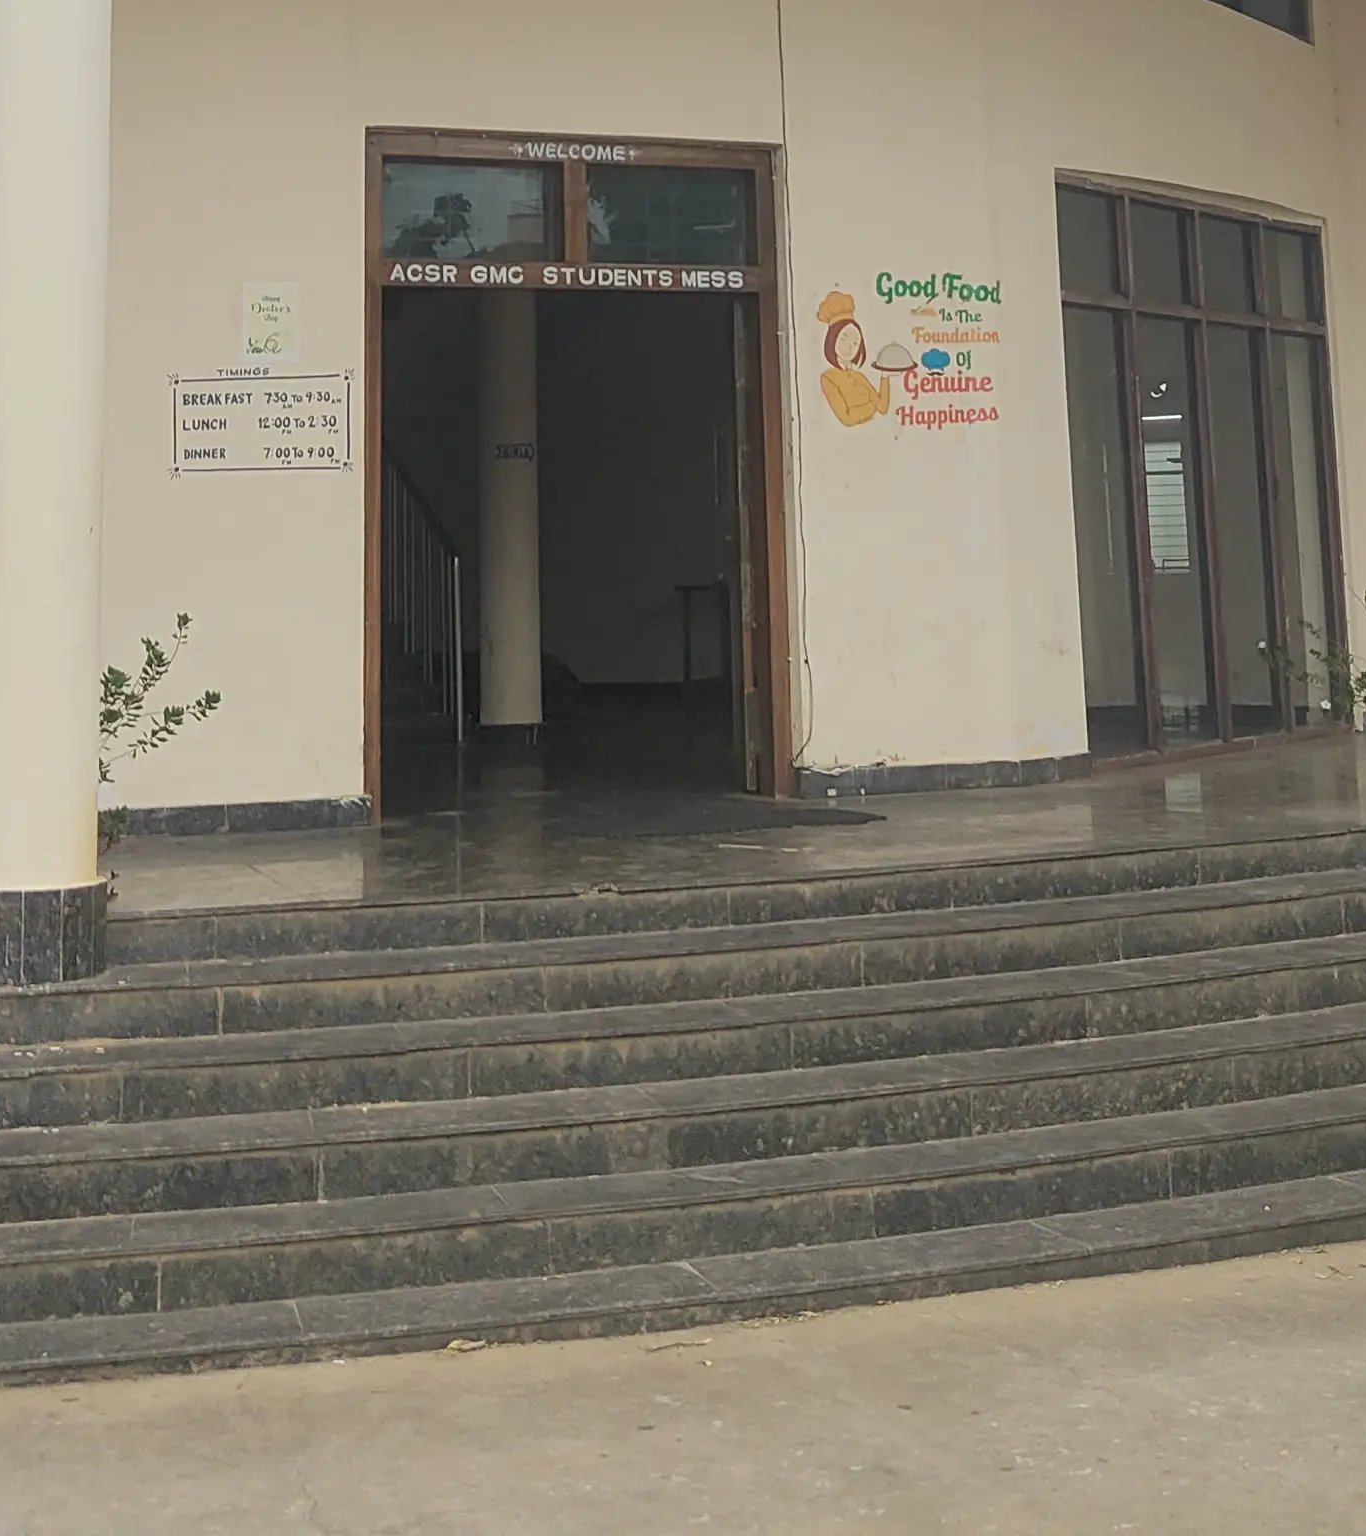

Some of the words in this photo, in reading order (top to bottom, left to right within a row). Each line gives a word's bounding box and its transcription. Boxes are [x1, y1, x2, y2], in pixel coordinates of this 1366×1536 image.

[525, 142, 627, 162] WELCOME
[390, 263, 457, 284] ACSR
[470, 266, 524, 285] GMC
[542, 266, 673, 288] STUDENTS
[681, 271, 744, 289] MESS
[876, 271, 938, 304] Good
[942, 272, 1002, 304] Food
[911, 326, 1000, 344] Foundation
[217, 367, 270, 377] TIMINGS
[903, 369, 994, 400] Genuine
[182, 418, 227, 431] LUNCH
[258, 416, 291, 429] 12:00
[308, 415, 337, 428] 2:30
[896, 404, 999, 430] Happiness
[184, 448, 226, 460] DINNER
[263, 447, 291, 459] 7:00
[307, 446, 335, 458] 9:00
